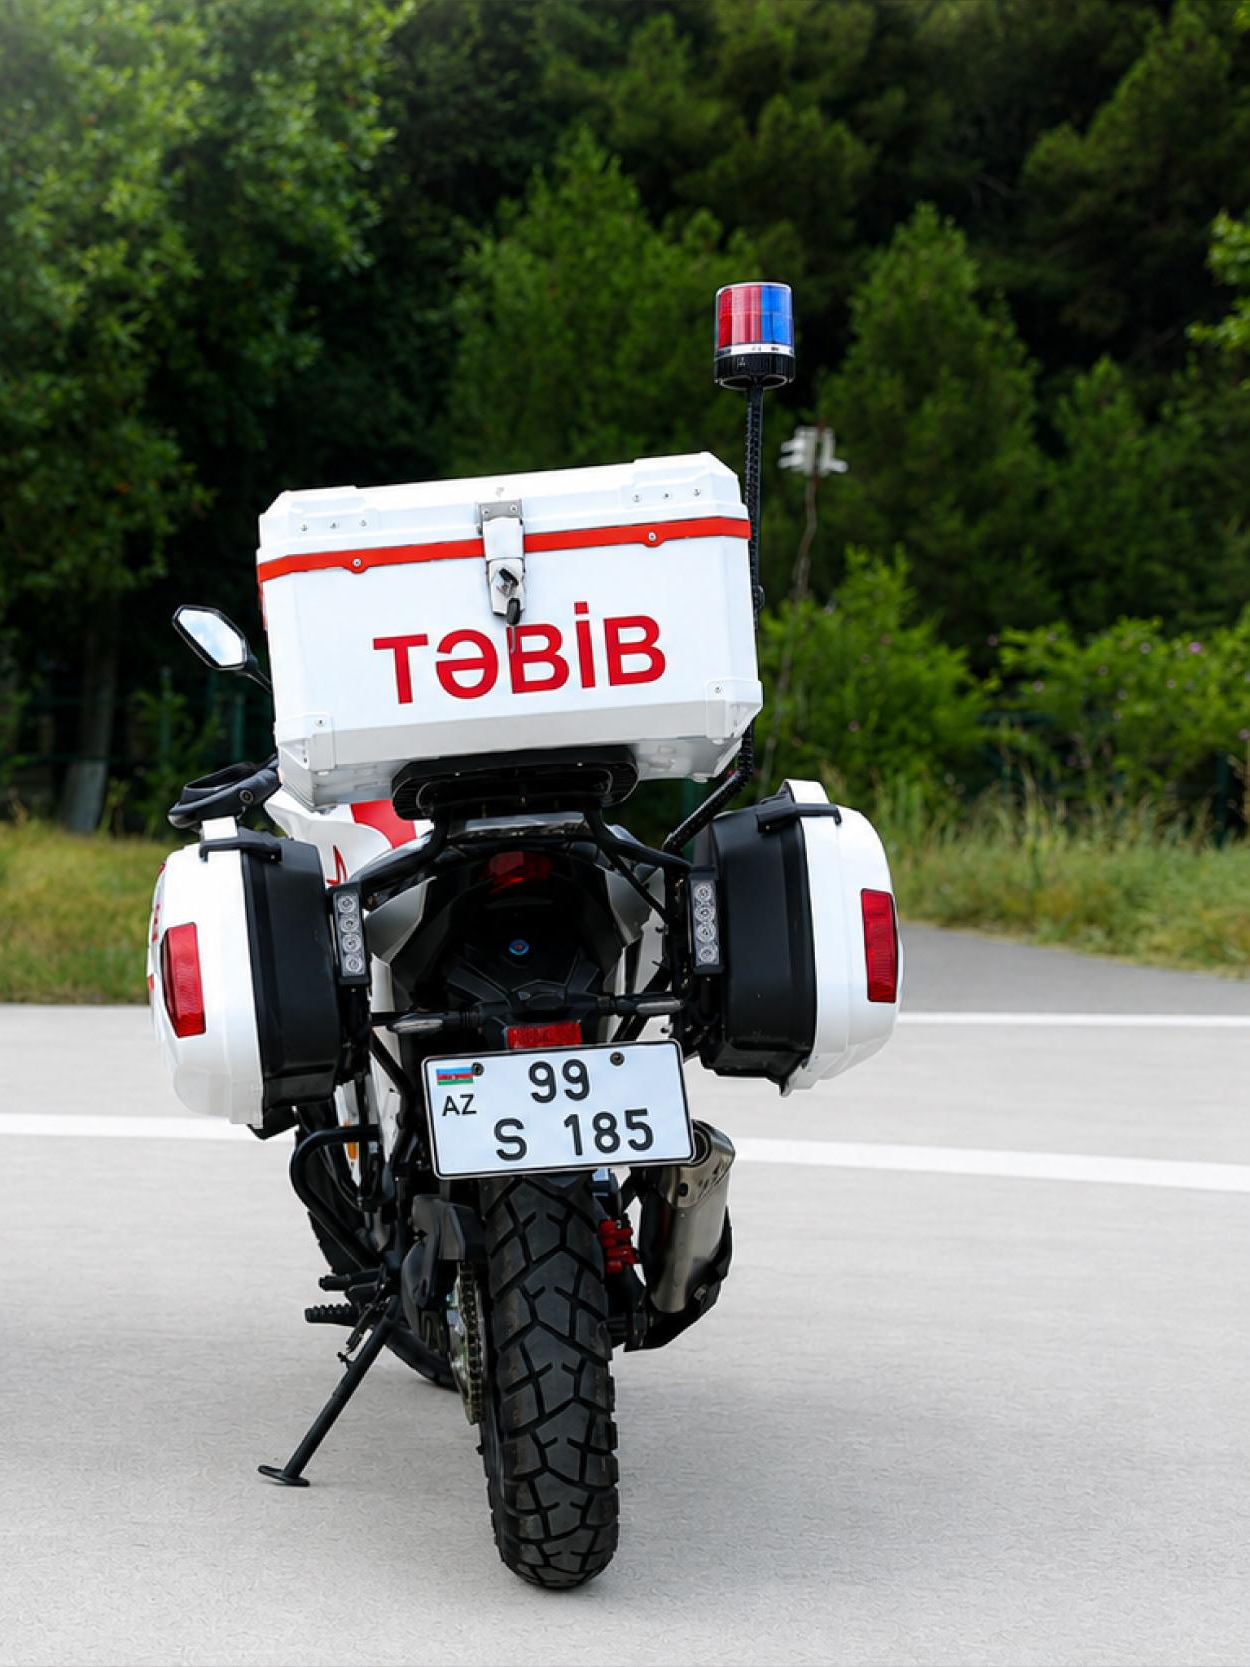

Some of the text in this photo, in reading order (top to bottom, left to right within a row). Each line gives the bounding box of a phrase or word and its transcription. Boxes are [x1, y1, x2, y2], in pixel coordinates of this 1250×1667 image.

[373, 601, 666, 704] TƏBİB
[442, 1094, 477, 1117] AZ
[528, 1058, 590, 1104] 99
[493, 1108, 654, 1161] S 185
